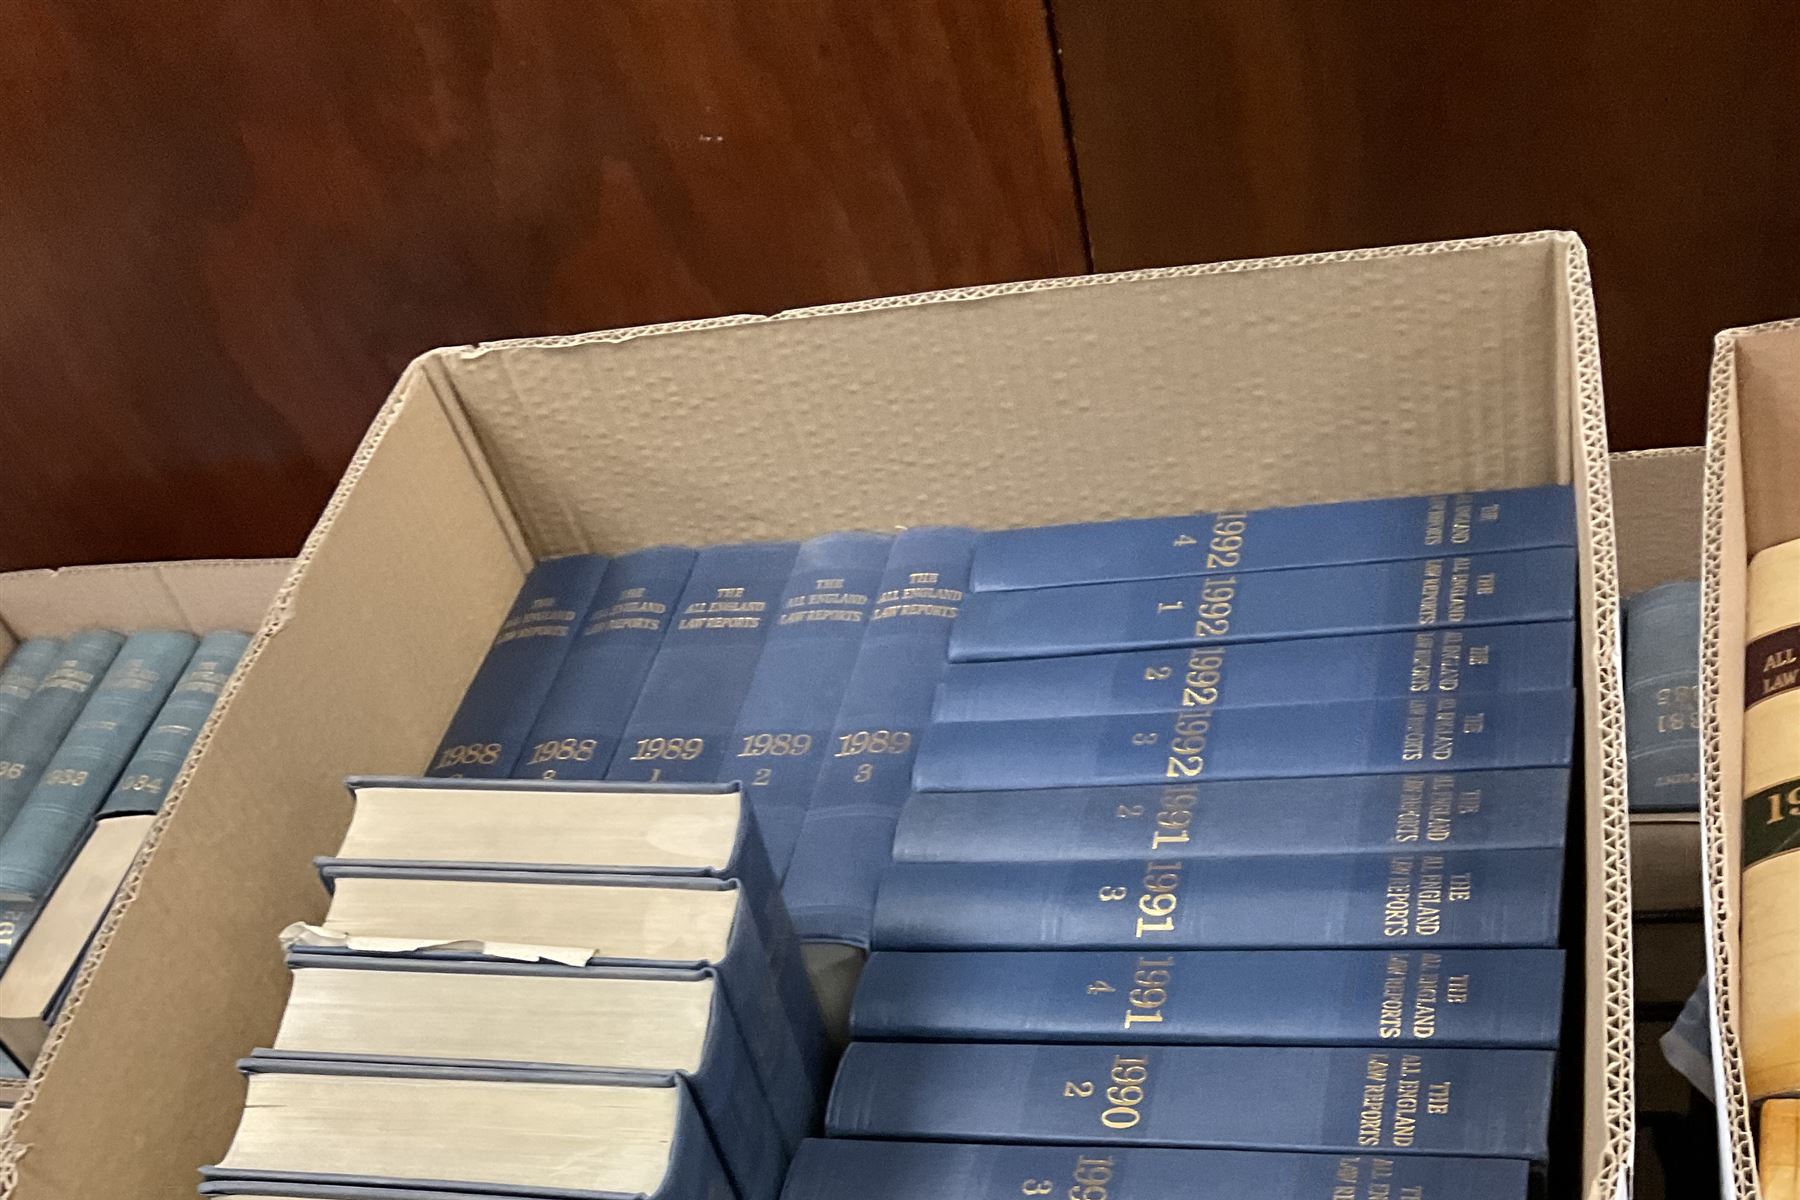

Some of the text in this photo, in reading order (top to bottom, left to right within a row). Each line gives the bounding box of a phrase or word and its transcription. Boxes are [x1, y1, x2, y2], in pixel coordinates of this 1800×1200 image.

[1173, 534, 1197, 547] 4
[1206, 511, 1248, 569] 1992
[815, 579, 845, 590] THE
[909, 573, 940, 584] THE
[717, 588, 746, 599] THE
[807, 593, 868, 605] ENGLAND
[878, 588, 963, 603] ALL ENGLAND
[684, 602, 766, 614] ALL ENGLAND
[806, 610, 863, 621] REPORTS
[872, 604, 960, 620] LAW REPORTS
[1157, 601, 1184, 613] 1
[1195, 575, 1237, 637] 1992
[678, 617, 761, 630] LAW REPORTS
[1763, 648, 1797, 673] ALL
[1143, 666, 1172, 681] 2
[1182, 647, 1226, 707] 1992
[1763, 668, 1800, 694] LAW
[631, 738, 703, 761] 1989
[737, 734, 812, 757] 1989
[835, 730, 911, 757] 1989
[1131, 732, 1159, 746] 3
[1166, 709, 1213, 777] 1992
[437, 743, 502, 770] 1988
[527, 738, 597, 765] 1988
[752, 768, 772, 786] 2
[854, 764, 873, 783] 3
[1117, 805, 1144, 818] 2
[1151, 785, 1198, 850] 1991
[1099, 886, 1127, 901] 3
[1449, 872, 1471, 902] THE
[1135, 861, 1183, 938] 1991
[1384, 877, 1411, 937] REPORTS
[1415, 874, 1444, 937] ENGLAND
[1087, 981, 1116, 995] 4
[1124, 957, 1175, 1029] 1991
[1447, 974, 1469, 1004] THE
[1379, 976, 1406, 1040] REPORTS
[1413, 973, 1439, 1040] ENGLAND
[1064, 1081, 1094, 1098] 2
[1101, 1055, 1148, 1129] 1990
[1358, 1053, 1389, 1147] LAW REPORTS
[1427, 1081, 1451, 1114] THE
[1392, 1080, 1420, 1147] ENGLAND
[1021, 1179, 1053, 1196] 3
